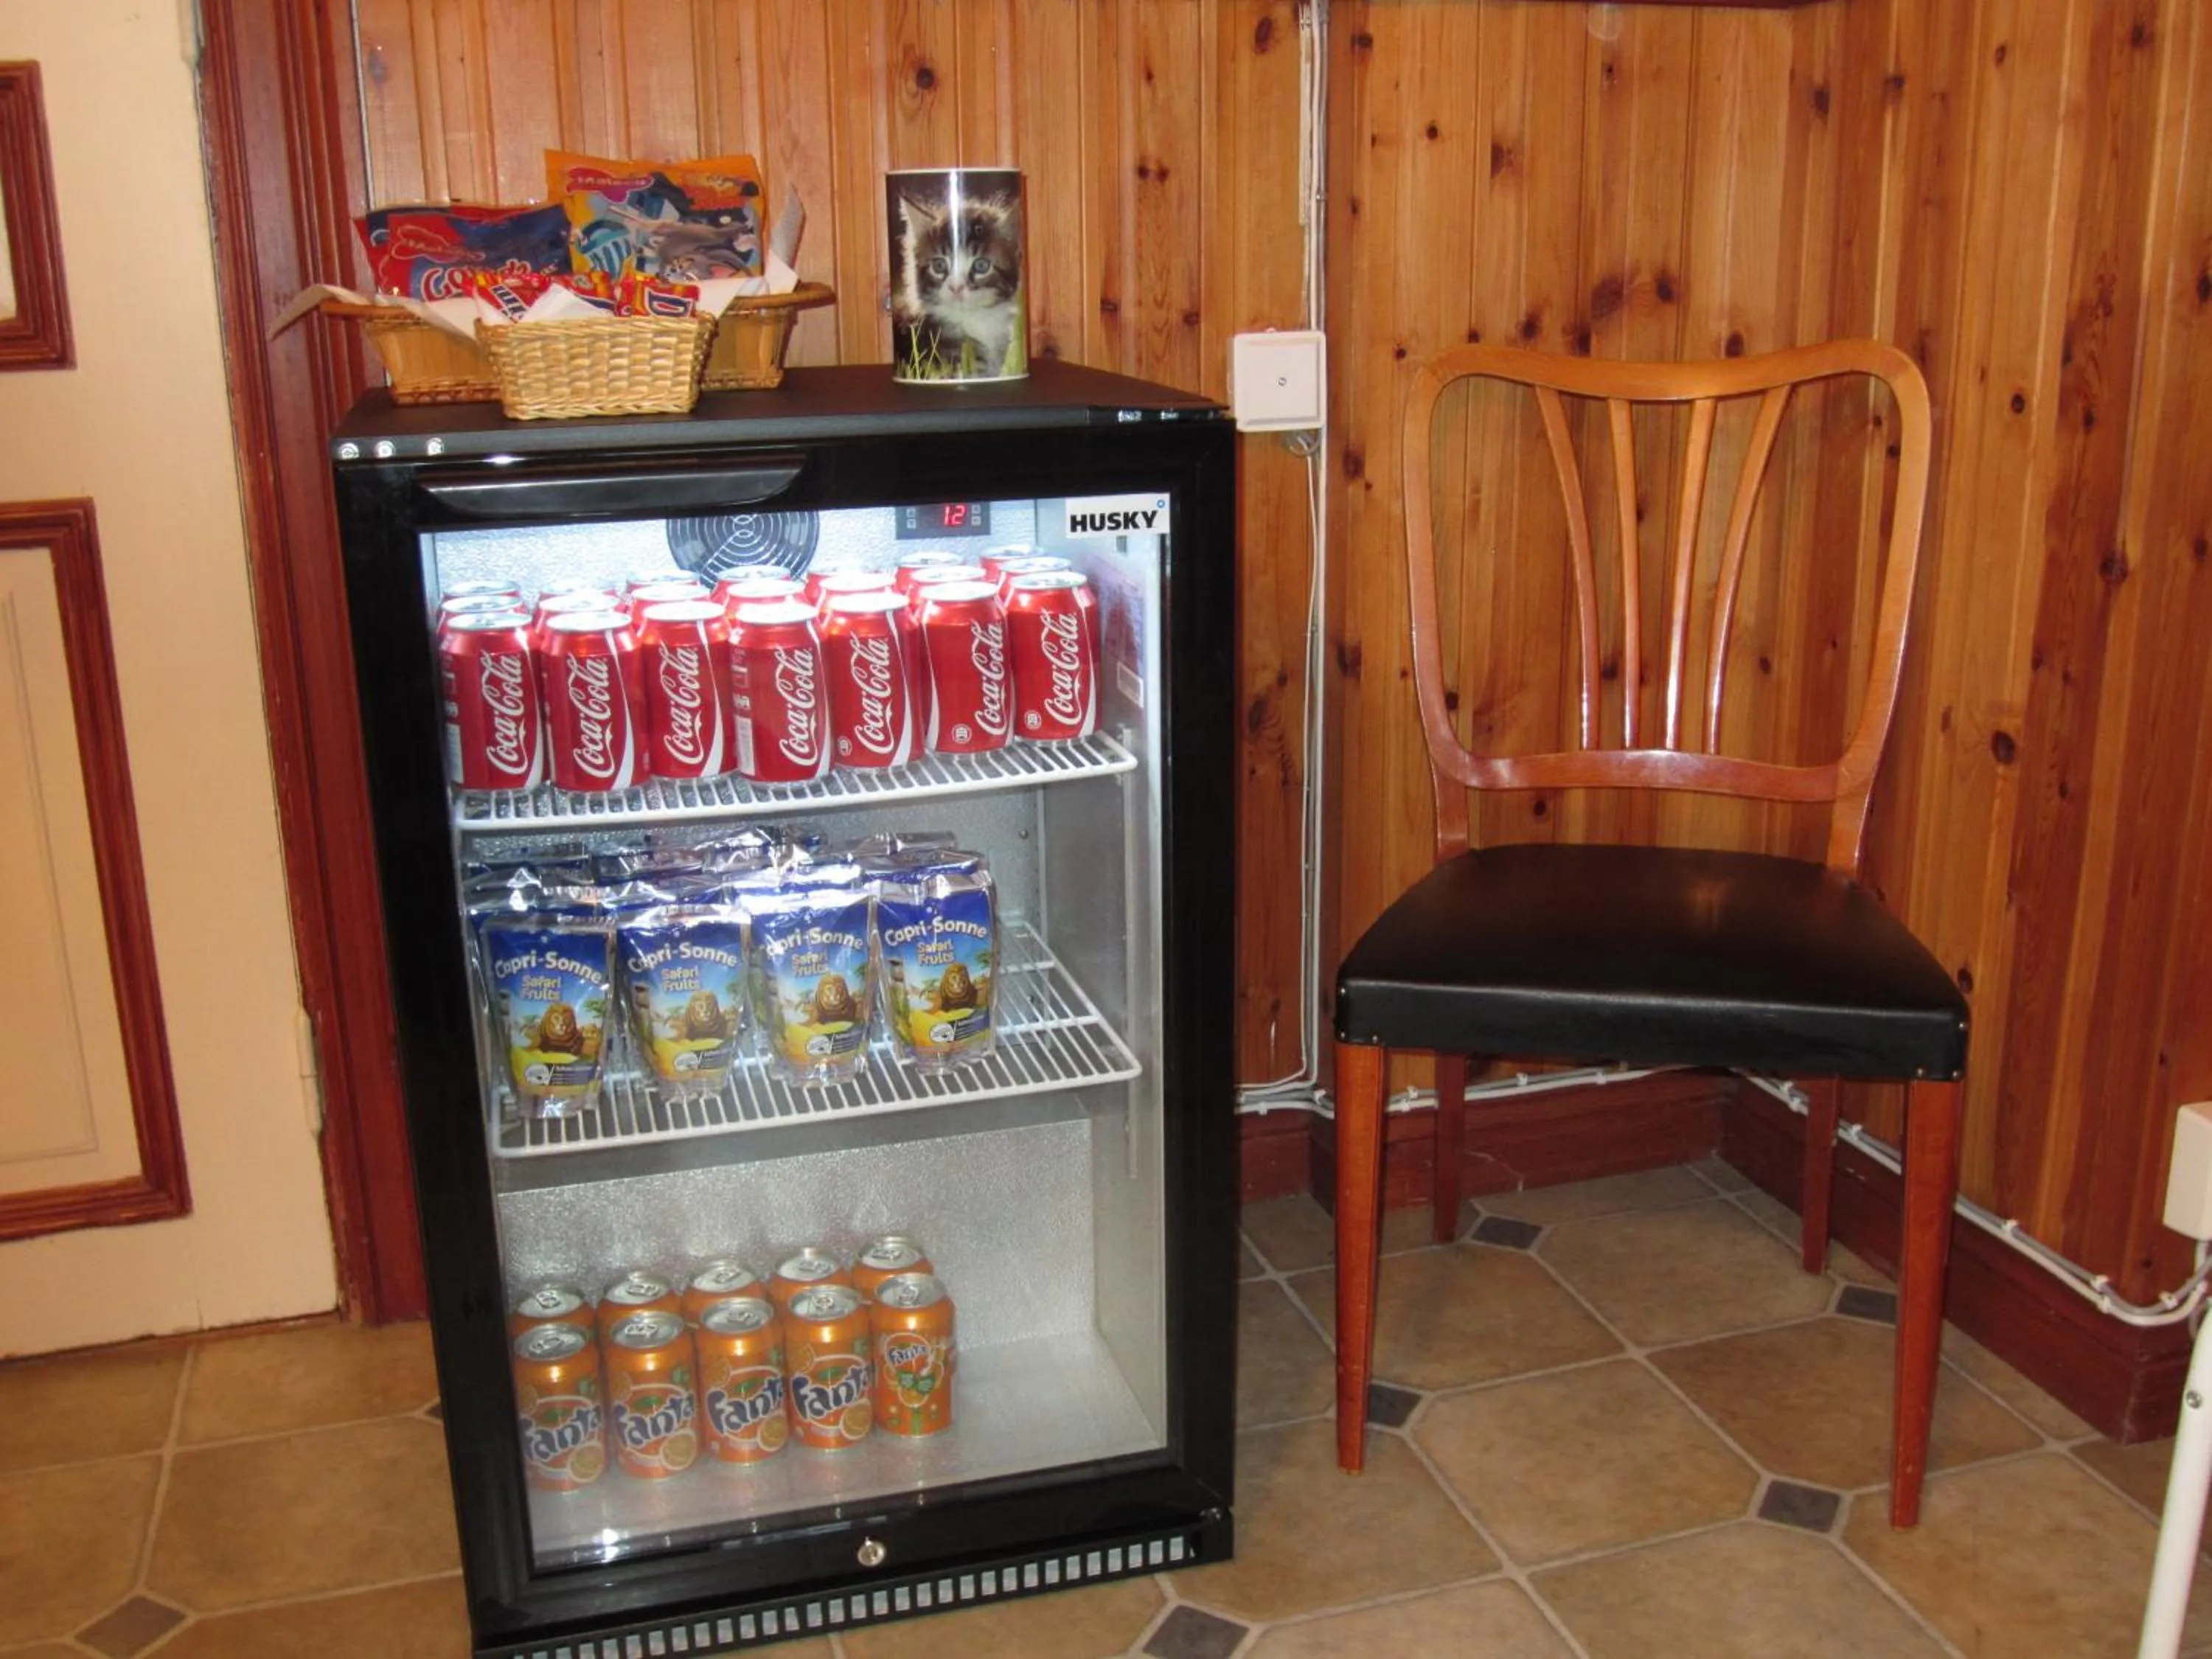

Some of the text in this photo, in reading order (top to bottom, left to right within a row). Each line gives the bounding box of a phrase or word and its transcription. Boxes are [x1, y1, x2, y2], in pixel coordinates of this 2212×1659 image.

[943, 504, 967, 527] 12
[1070, 509, 1158, 533] HUSKY
[884, 915, 987, 947] Capri-Sonne
[495, 950, 602, 984] Capri-Sonne
